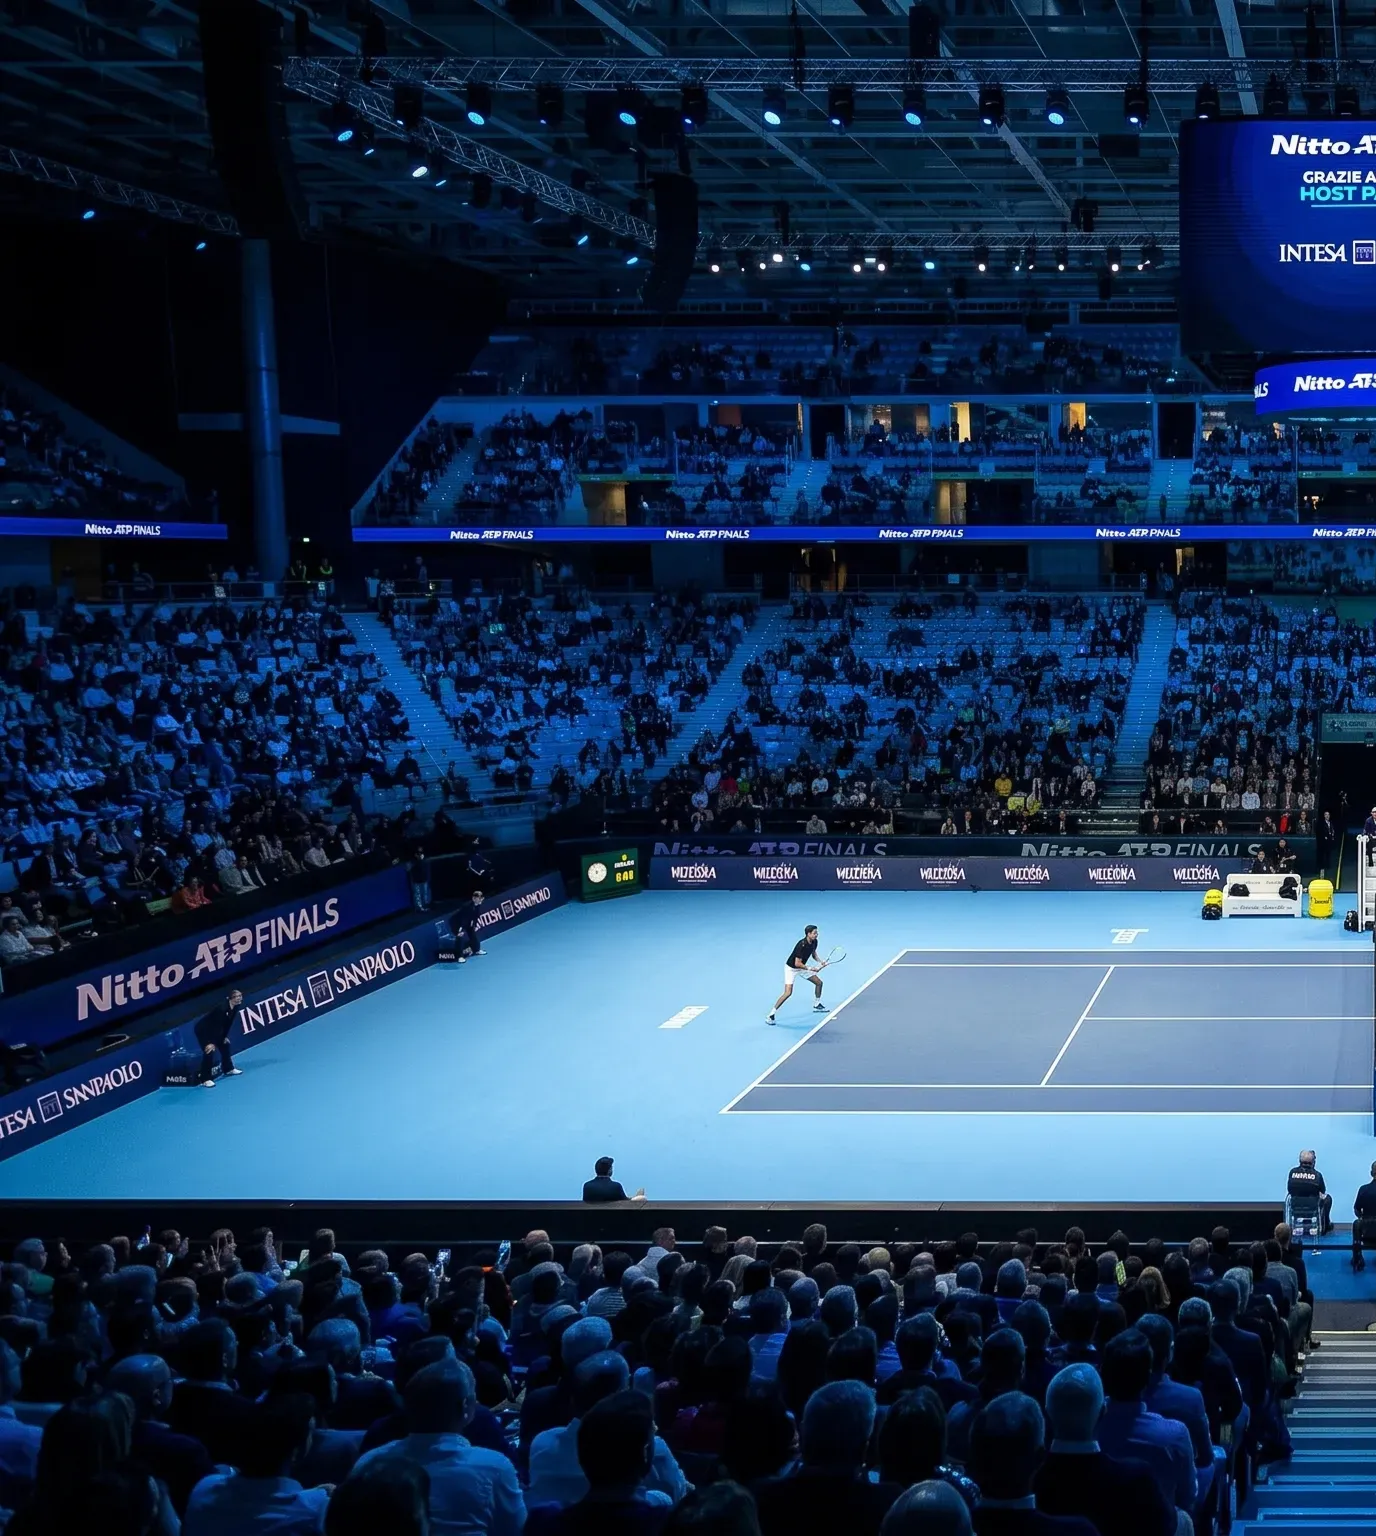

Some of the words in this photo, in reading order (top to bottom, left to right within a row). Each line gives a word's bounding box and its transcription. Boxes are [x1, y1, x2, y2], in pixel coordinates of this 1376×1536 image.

[1270, 134, 1350, 155] Nitto
[1302, 170, 1361, 184] GRAZIE
[1300, 186, 1357, 201] HOST
[1278, 243, 1348, 263] INTESA
[1294, 375, 1346, 392] Nitto
[85, 524, 112, 535] Nitto
[133, 525, 161, 536] FINALS
[879, 530, 908, 538] Nitto
[76, 963, 185, 1021] Nitto
[183, 928, 252, 979] ATP
[255, 898, 340, 954] FINALS
[239, 985, 308, 1035] INTESA
[333, 940, 415, 994] SANPAOLO
[63, 1060, 143, 1109] SANPAOLO
